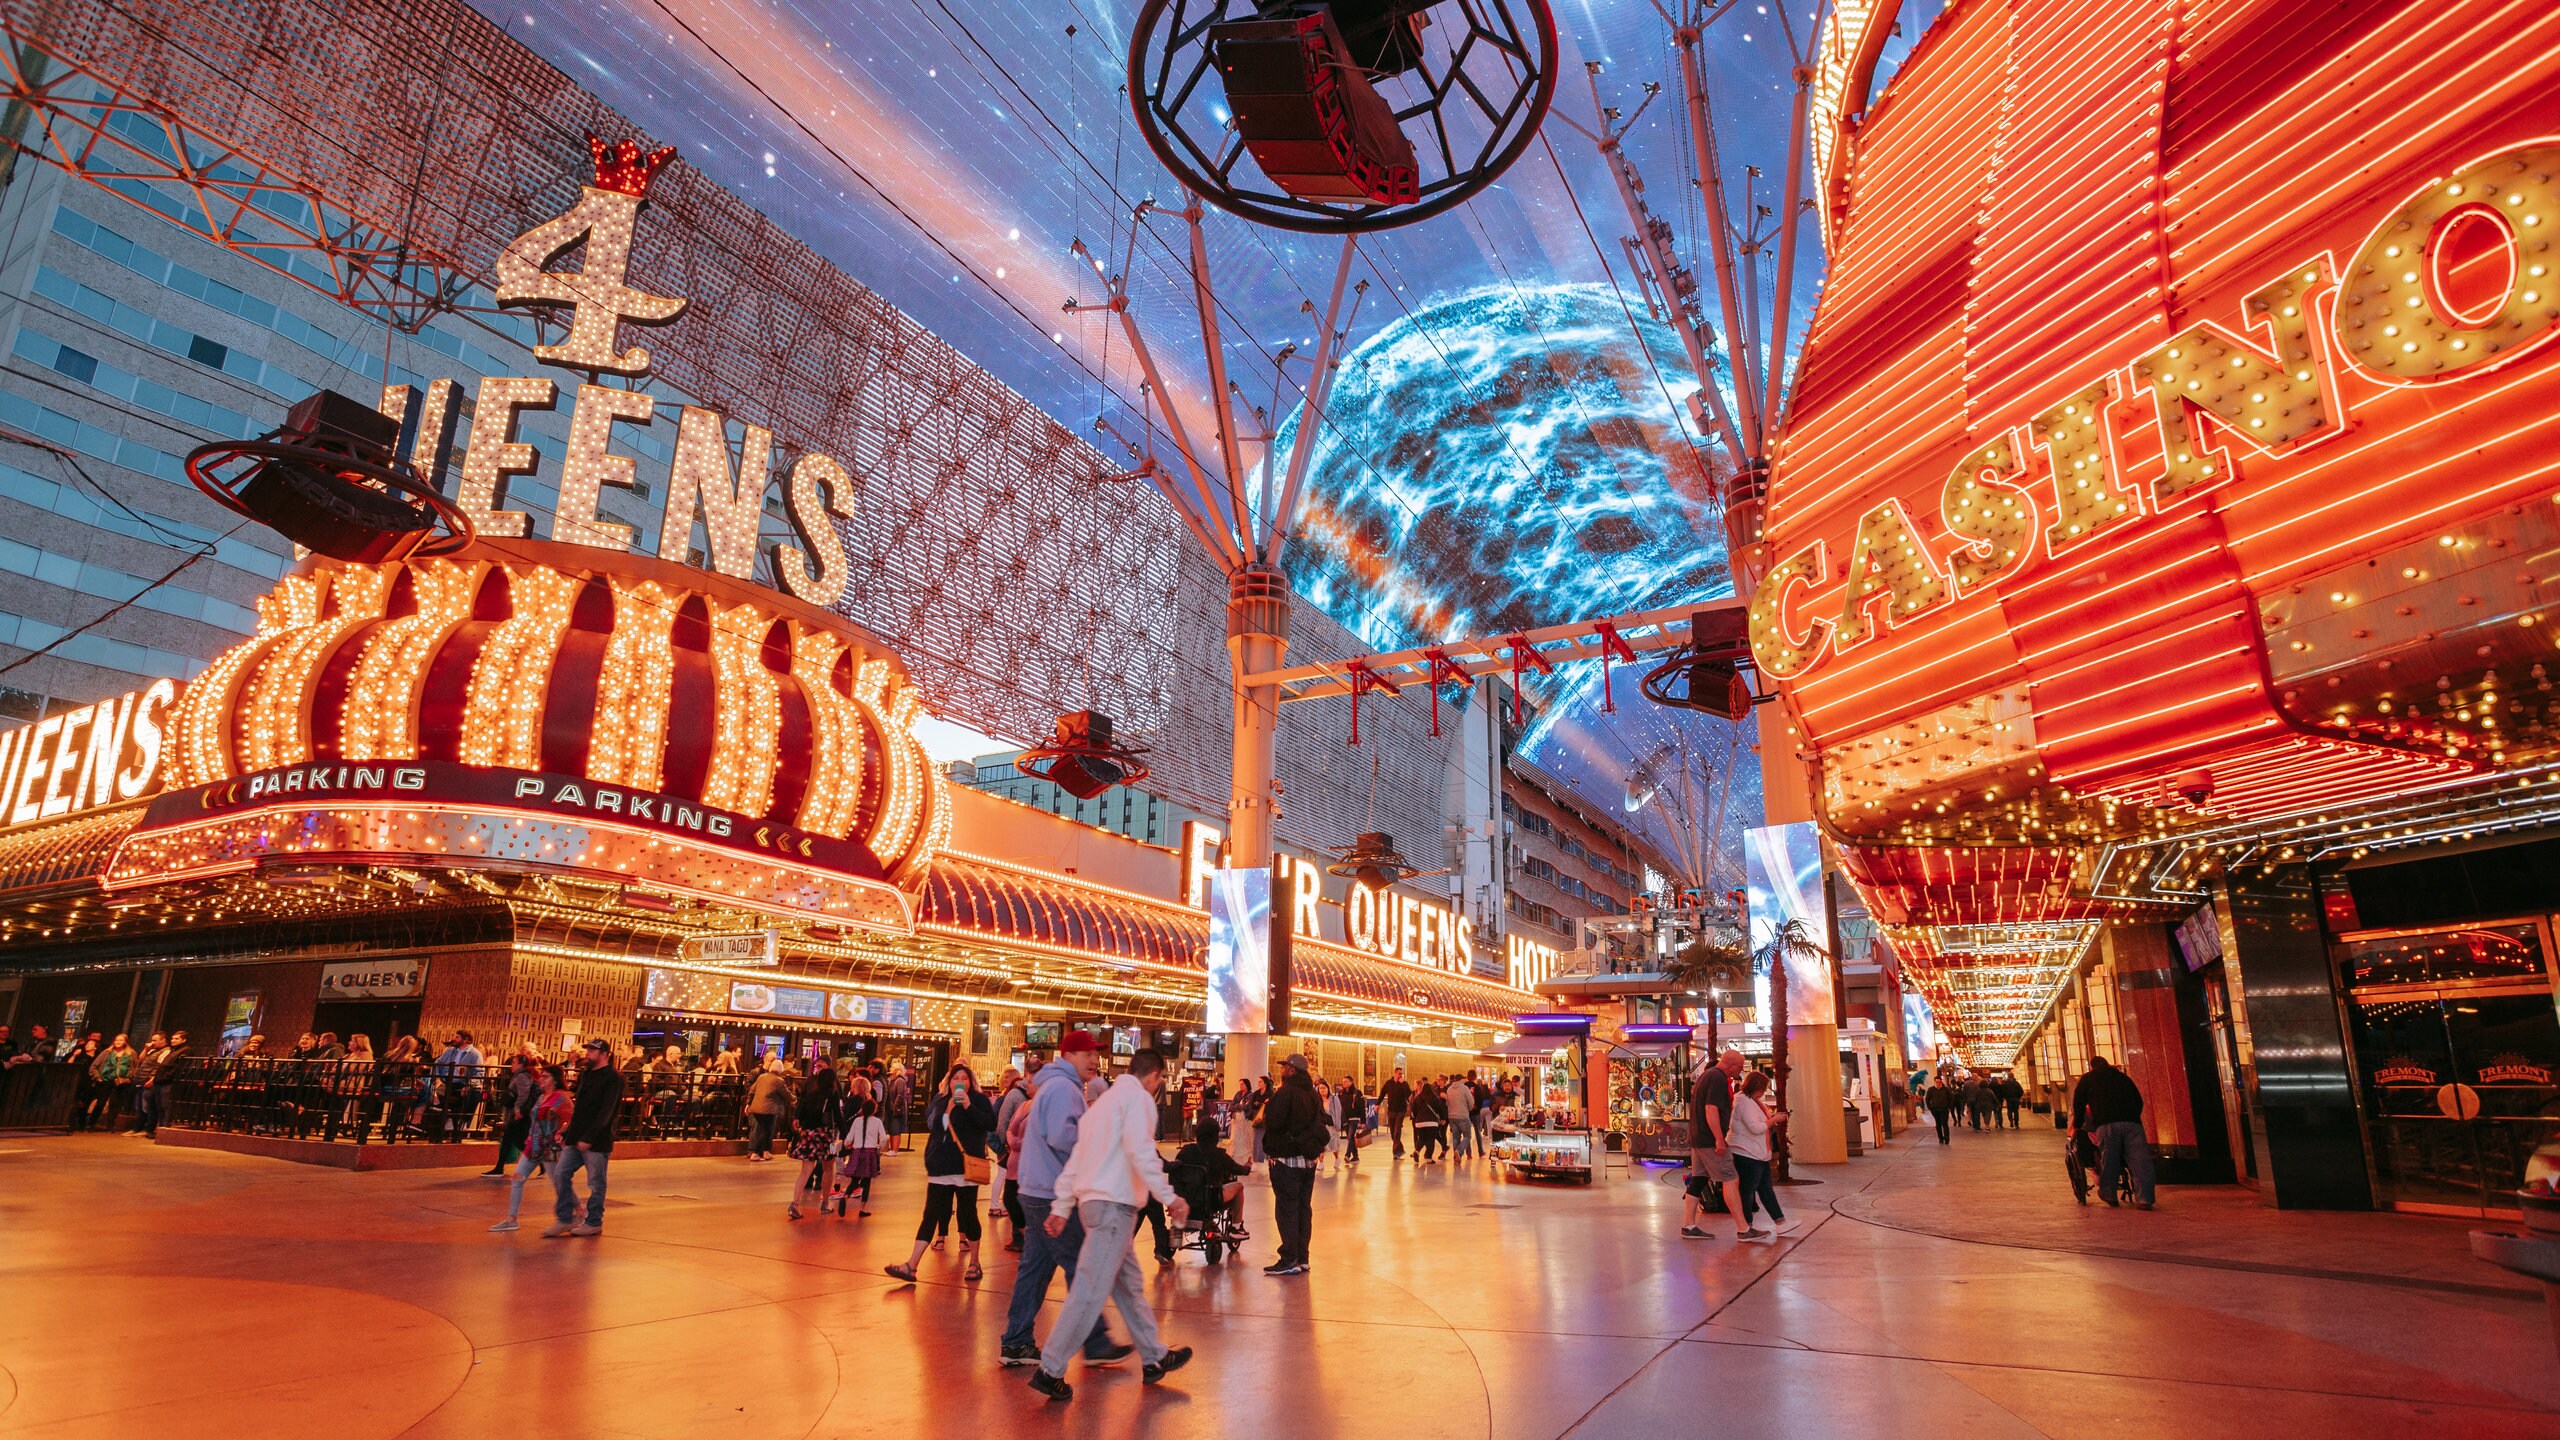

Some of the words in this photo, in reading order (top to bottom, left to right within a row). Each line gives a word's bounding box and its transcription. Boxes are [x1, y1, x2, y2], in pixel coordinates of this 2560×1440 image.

[496, 186, 688, 378] 4
[1749, 136, 2560, 680] CASINO
[381, 376, 854, 607] UEENS
[249, 767, 425, 799] PARKING
[513, 777, 732, 838] PARKING
[1187, 821, 1321, 940] FR
[1348, 881, 1473, 975] QUEENS
[728, 938, 749, 953] TACO
[323, 975, 336, 988] 4
[341, 971, 418, 988] QUEENS
[1506, 1056, 1516, 1064] BUY
[1518, 1056, 1522, 1064] 3
[1523, 1056, 1533, 1064] GET
[1540, 1057, 1552, 1065] FREE
[2374, 1067, 2437, 1083] FREMONT
[2477, 1065, 2551, 1083] FREMONT
